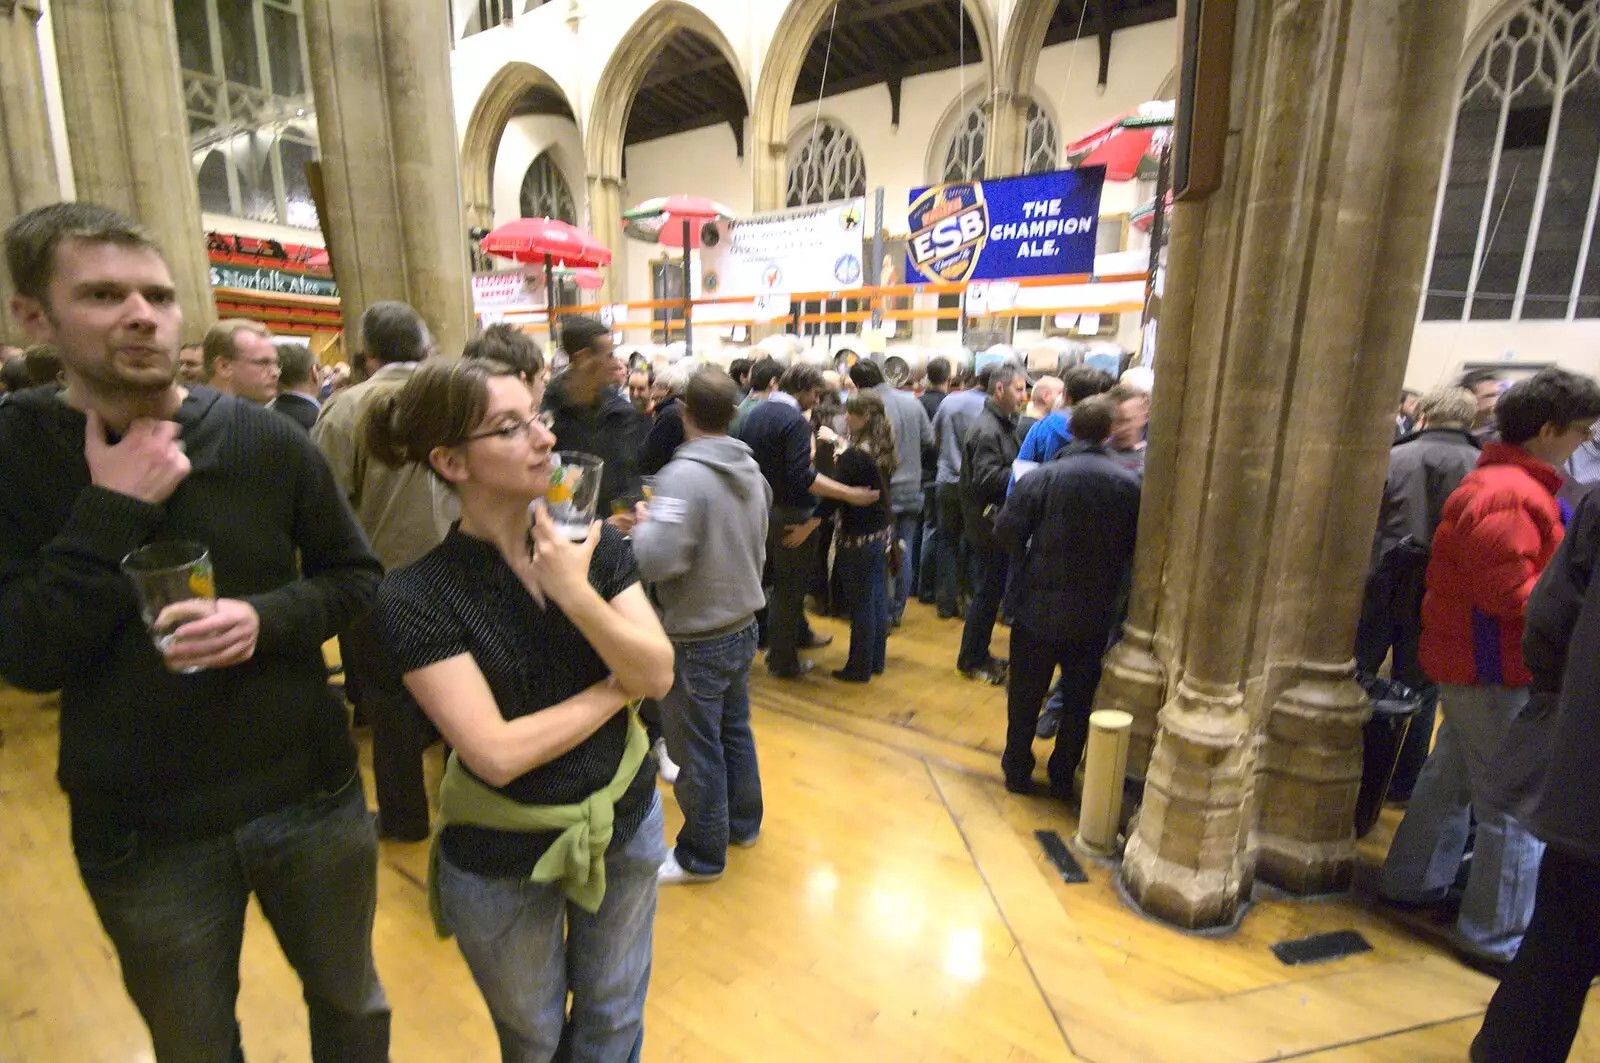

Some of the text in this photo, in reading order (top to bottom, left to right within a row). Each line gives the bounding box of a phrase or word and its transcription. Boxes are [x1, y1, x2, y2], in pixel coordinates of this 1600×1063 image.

[1022, 198, 1062, 219] THE
[914, 210, 984, 264] ESB
[990, 215, 1092, 241] CHAMPION
[222, 268, 285, 293] Norfolk
